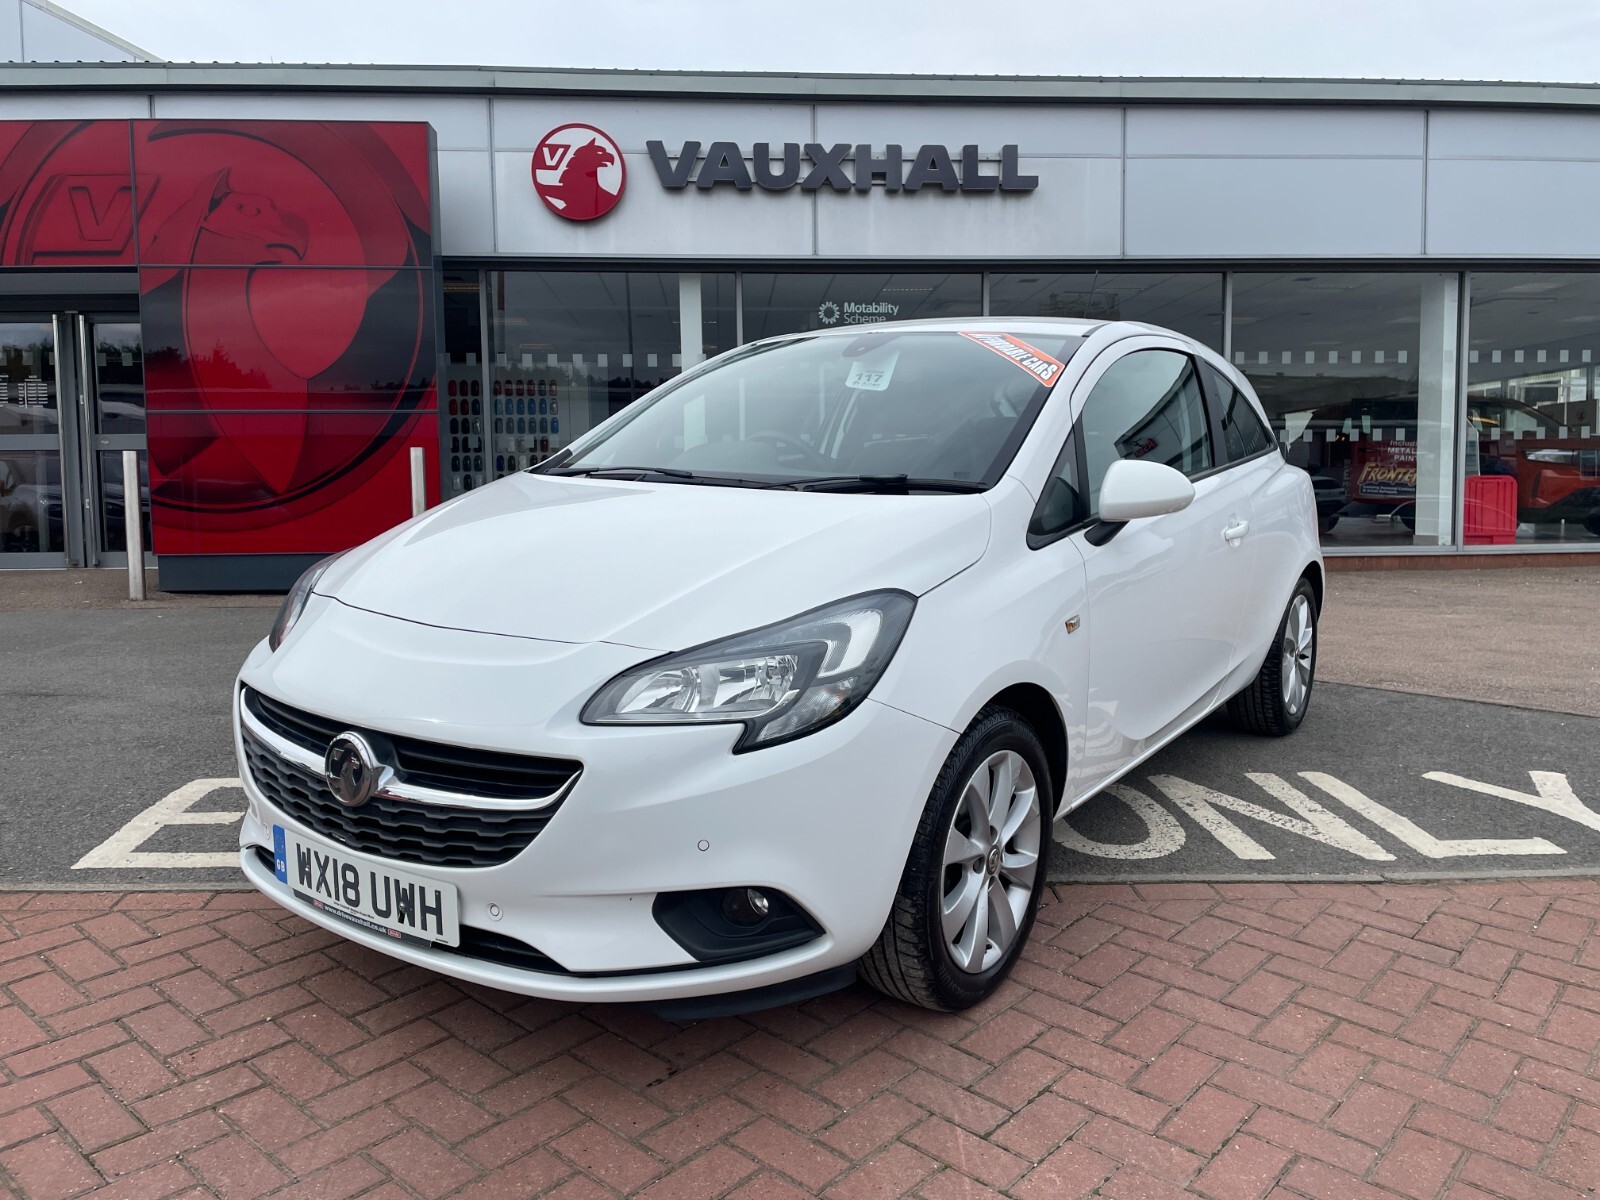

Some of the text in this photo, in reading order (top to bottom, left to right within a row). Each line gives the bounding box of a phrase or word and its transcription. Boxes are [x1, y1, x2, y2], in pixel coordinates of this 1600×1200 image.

[542, 147, 565, 167] V
[645, 139, 1038, 193] VAUXHALL
[843, 302, 899, 316] Motability
[843, 313, 887, 324] Scheme
[855, 373, 884, 382] 117
[1021, 358, 1058, 380] CARS
[1387, 447, 1417, 455] METAL
[1053, 770, 1600, 861] ONLY
[276, 858, 286, 872] GB
[296, 843, 443, 936] WX18 UWH
